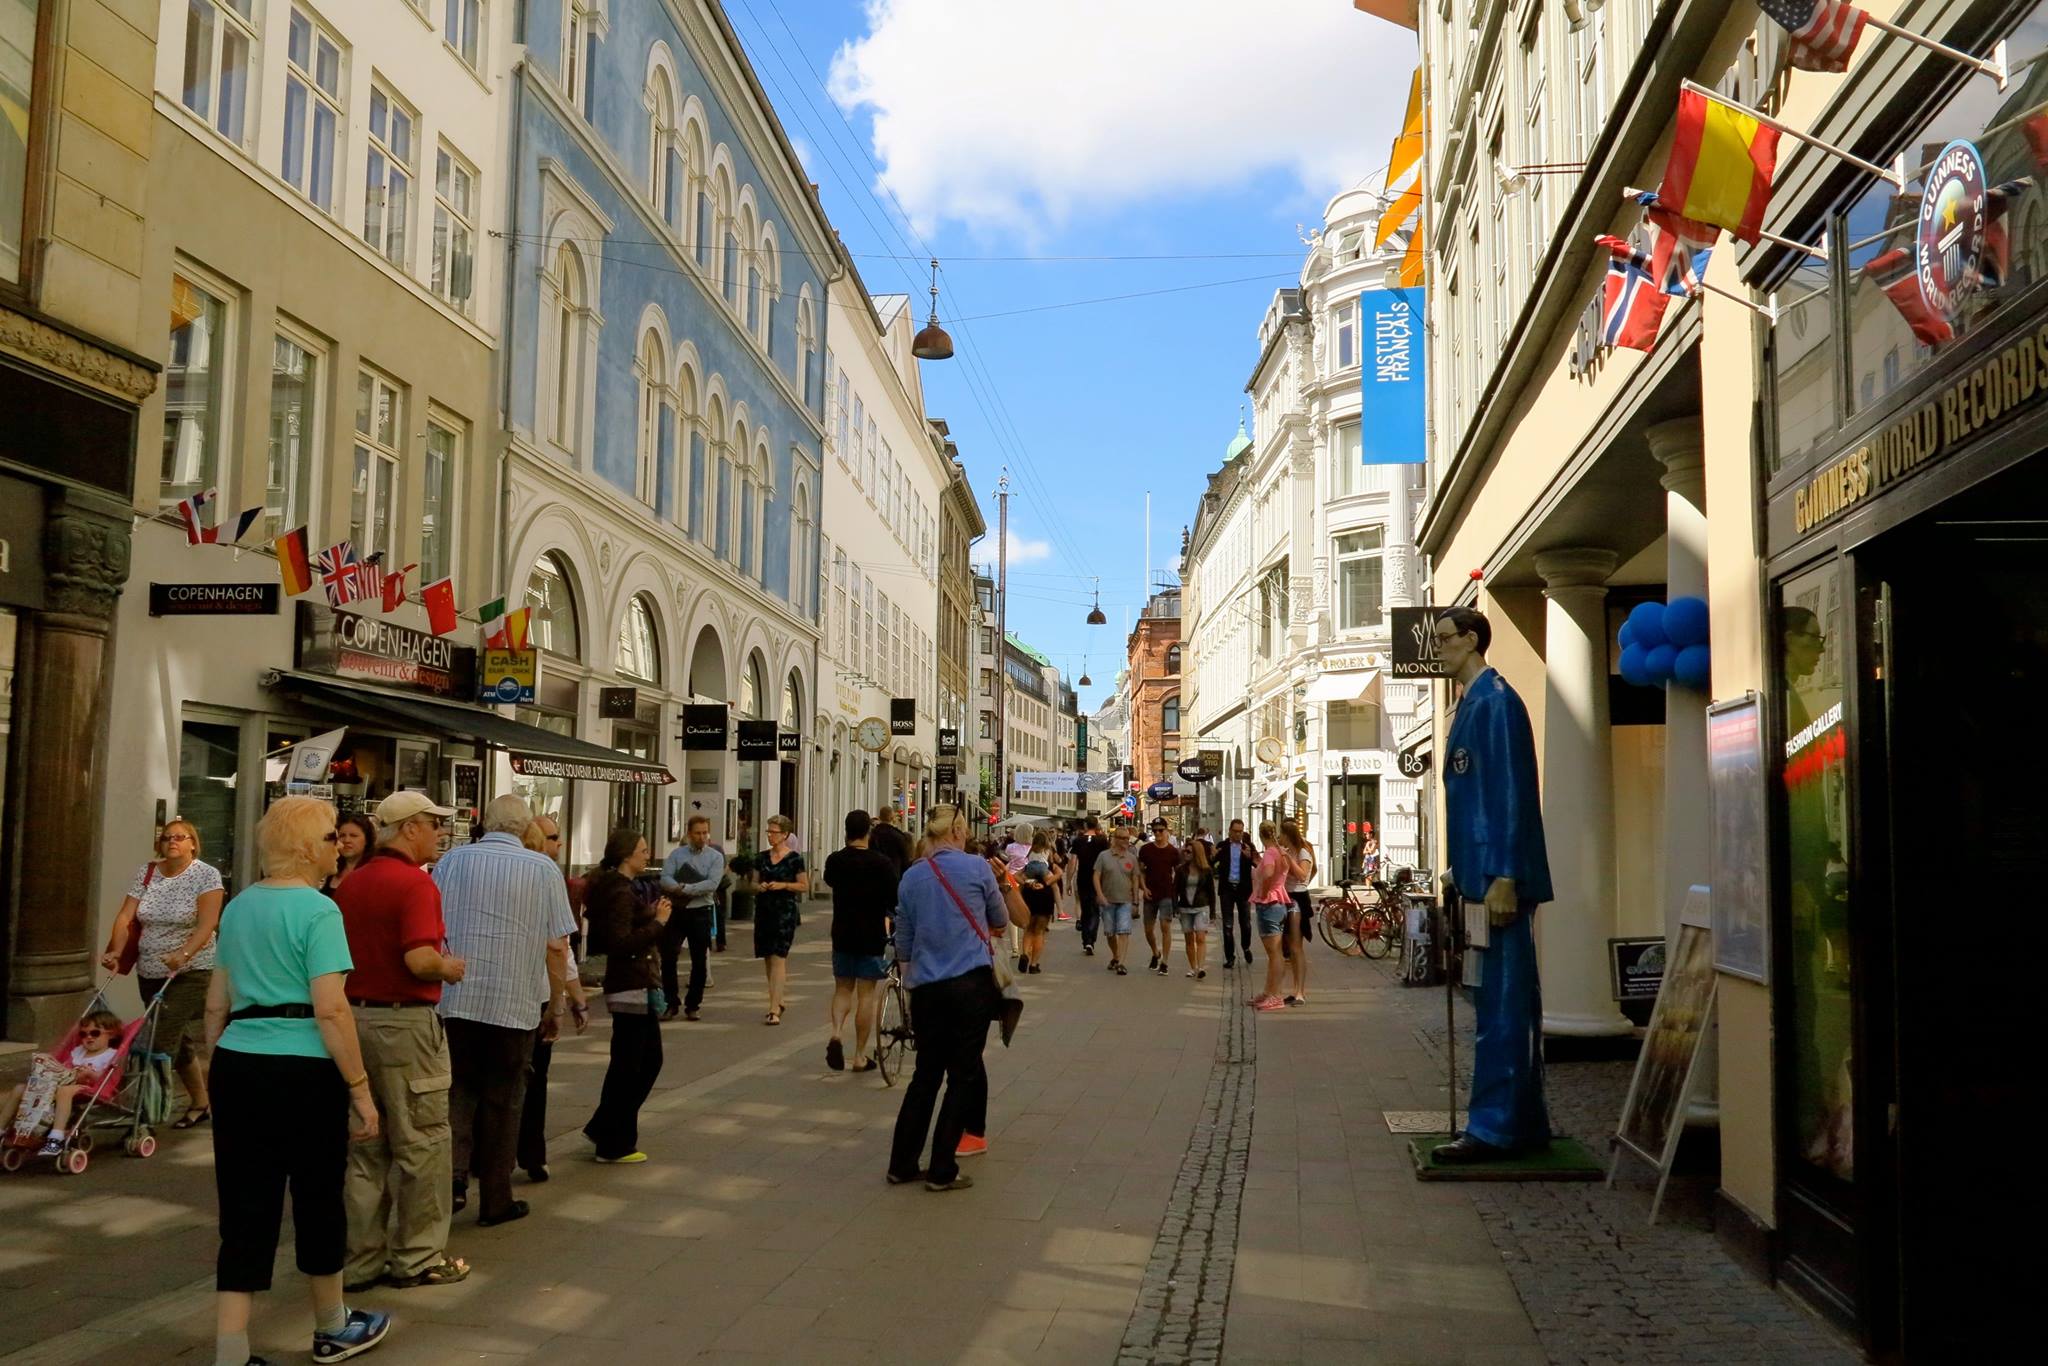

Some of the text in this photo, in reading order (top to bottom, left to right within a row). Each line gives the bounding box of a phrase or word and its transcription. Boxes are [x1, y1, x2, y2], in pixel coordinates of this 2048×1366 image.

[1925, 151, 1976, 221] GUINNESS
[1920, 195, 1983, 310] WORLD RECORDS
[1376, 312, 1394, 382] INSTITUT
[1795, 323, 2048, 533] GUINNESS WORLD RECORDS
[168, 587, 263, 600] COPENHAGEN
[341, 615, 451, 669] COPENHAGEN
[341, 652, 451, 694] souvenir & design
[491, 656, 529, 666] CASH
[1329, 657, 1365, 669] ROLEX
[1395, 662, 1445, 674] MONCL
[781, 738, 797, 747] KM
[1785, 724, 1814, 759] FASHION
[1812, 701, 1842, 738] GALLERY
[523, 759, 663, 784] COPENHAGEN SOUVENIR & DANISH DESIGN TAX FREE
[1323, 758, 1382, 771] KLALUND
